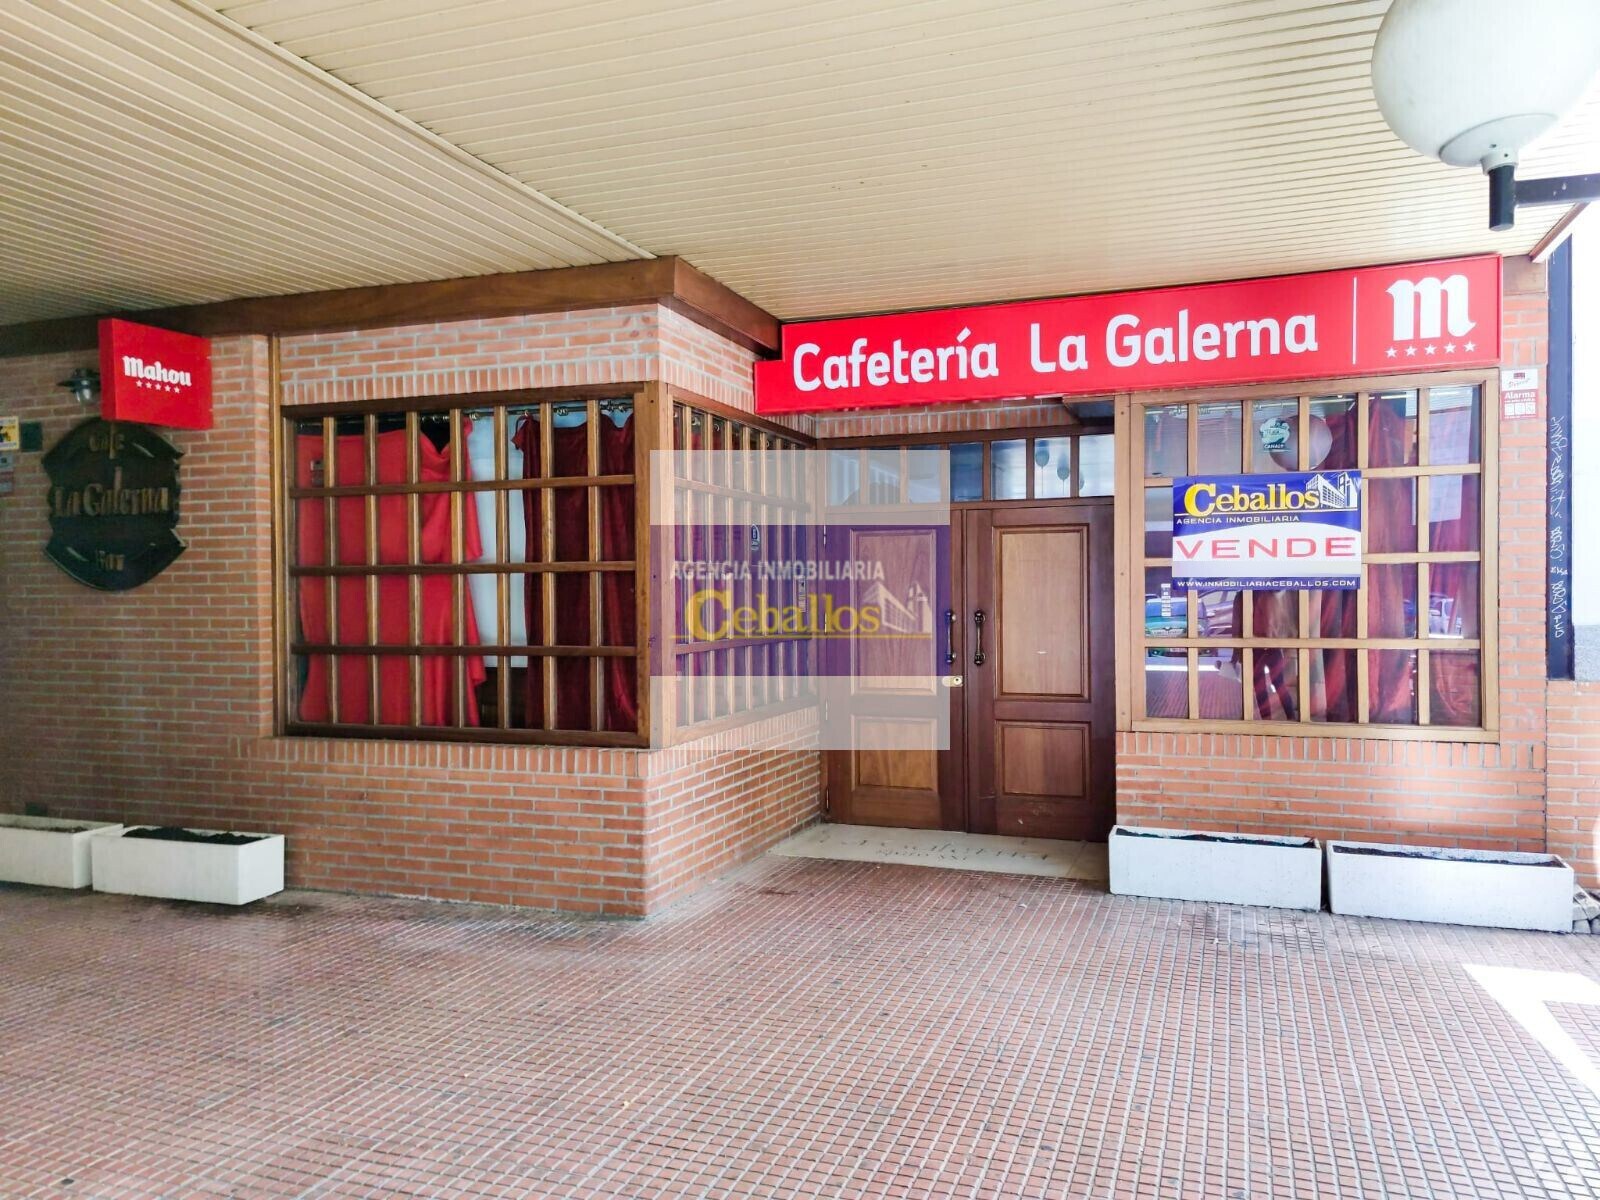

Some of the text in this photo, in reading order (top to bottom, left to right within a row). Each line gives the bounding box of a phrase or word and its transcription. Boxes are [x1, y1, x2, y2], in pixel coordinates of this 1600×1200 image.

[793, 309, 1318, 392] Cafetería La Galerna
[122, 355, 192, 387] Mahou
[1504, 391, 1536, 400] Alarma
[55, 466, 170, 516] La Galerna
[1183, 482, 1320, 517] Ceballos
[1176, 515, 1300, 525] AGENCIA INMOBILIARIA
[1176, 537, 1356, 560] VENDE
